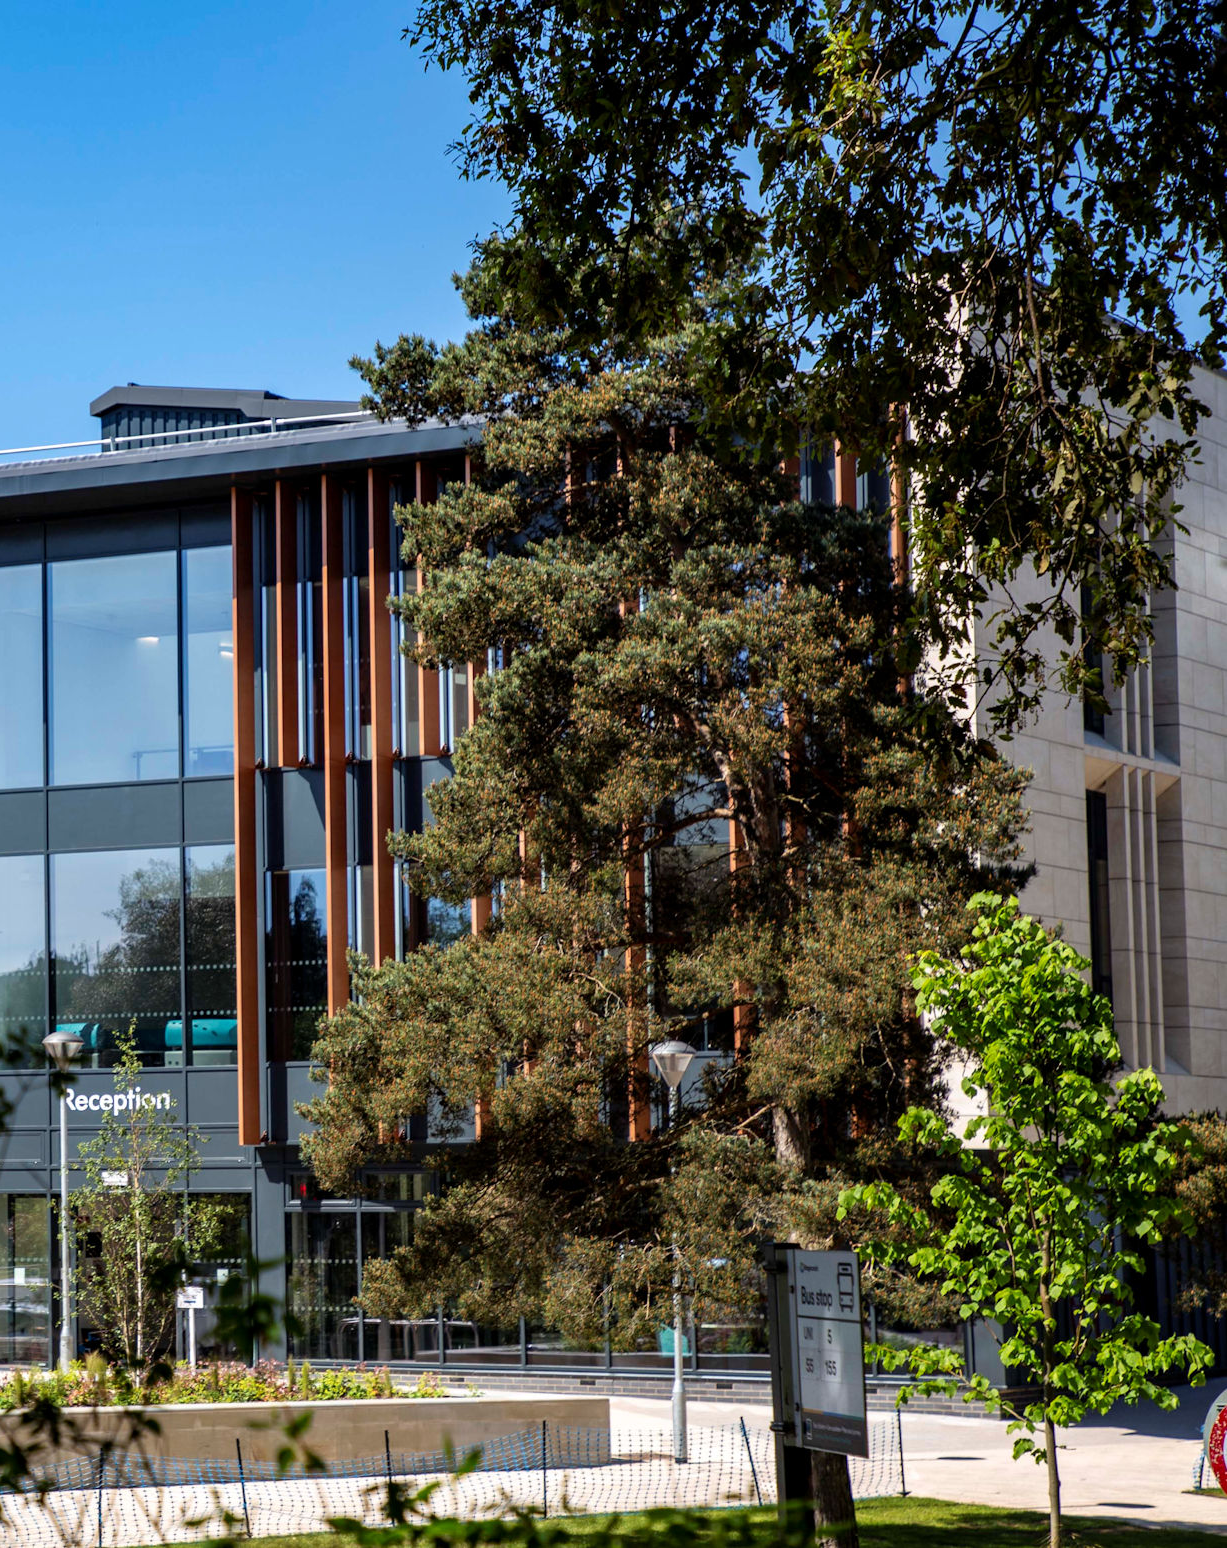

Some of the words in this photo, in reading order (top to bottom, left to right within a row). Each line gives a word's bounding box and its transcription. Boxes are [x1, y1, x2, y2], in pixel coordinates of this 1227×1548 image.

[65, 1086, 171, 1117] Reception
[801, 1285, 815, 1305] Bus
[816, 1289, 833, 1312] stop
[827, 1328, 833, 1345] 5
[825, 1360, 837, 1376] 155
